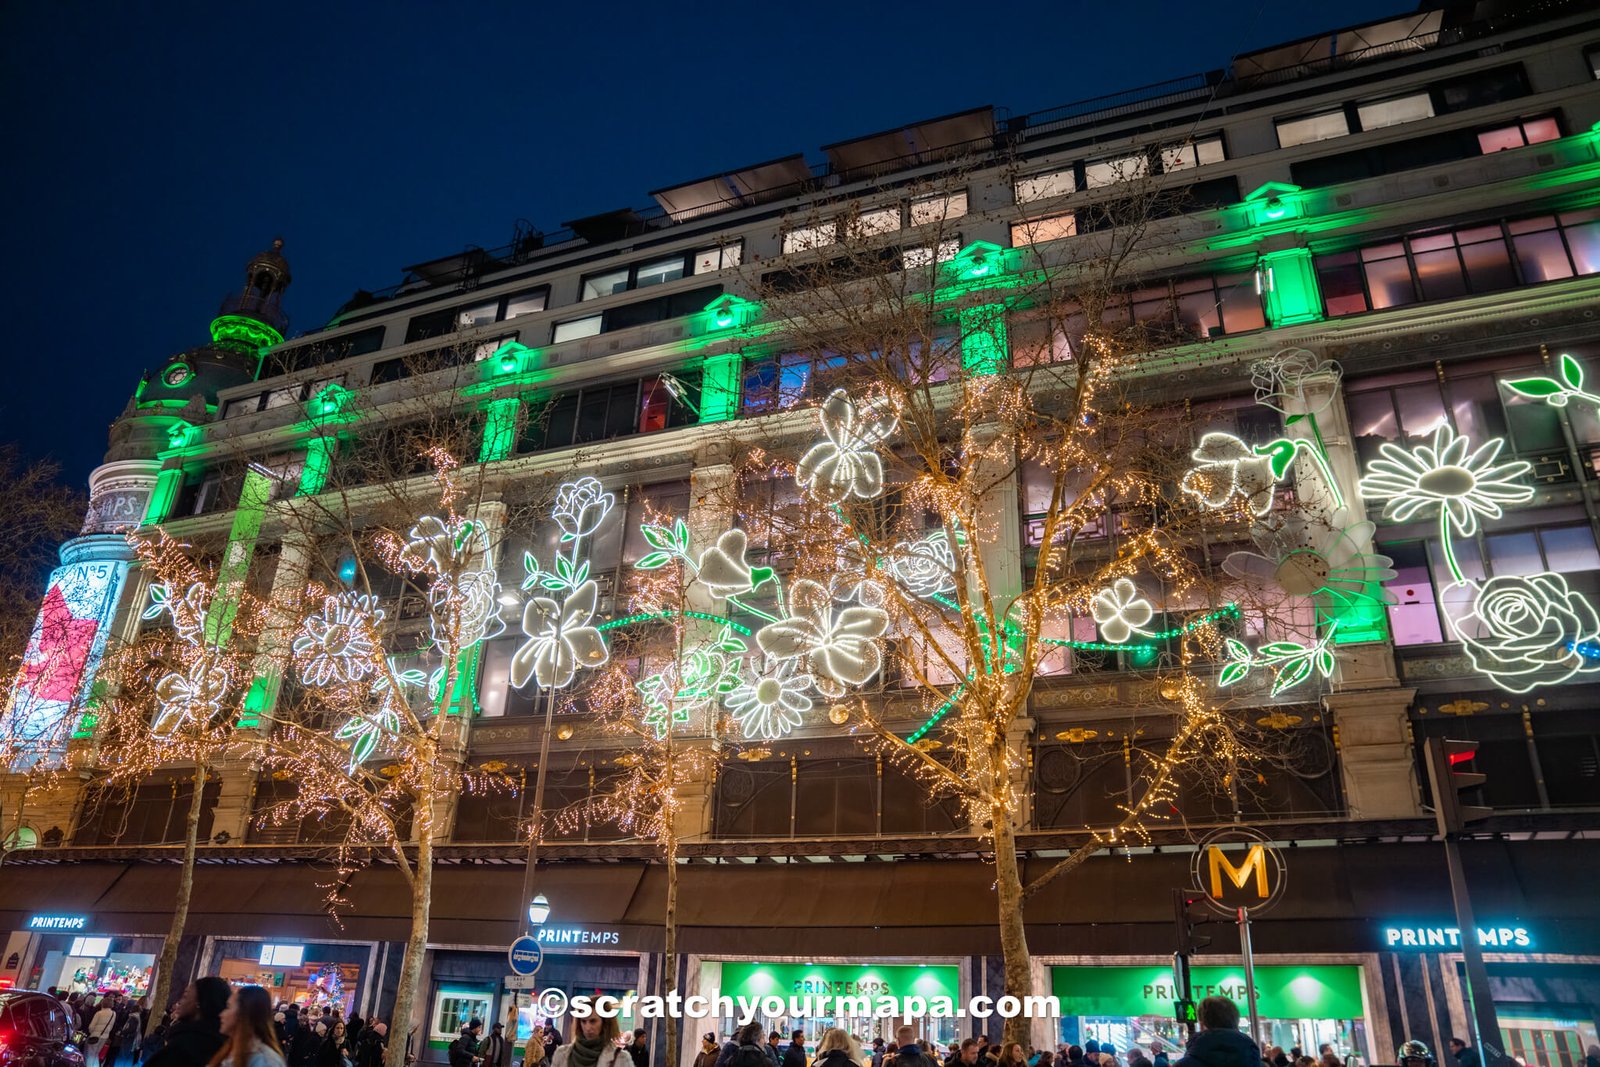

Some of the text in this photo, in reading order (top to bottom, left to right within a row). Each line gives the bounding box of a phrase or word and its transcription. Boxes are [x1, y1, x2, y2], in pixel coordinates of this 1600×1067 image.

[1208, 845, 1269, 899] M
[30, 916, 85, 929] PRINTEMPS
[537, 929, 620, 945] PRINTEMPS
[1386, 927, 1530, 946] PRINTMPS
[793, 980, 890, 995] PRINTEMPS
[1143, 984, 1261, 1000] PRITEMPS
